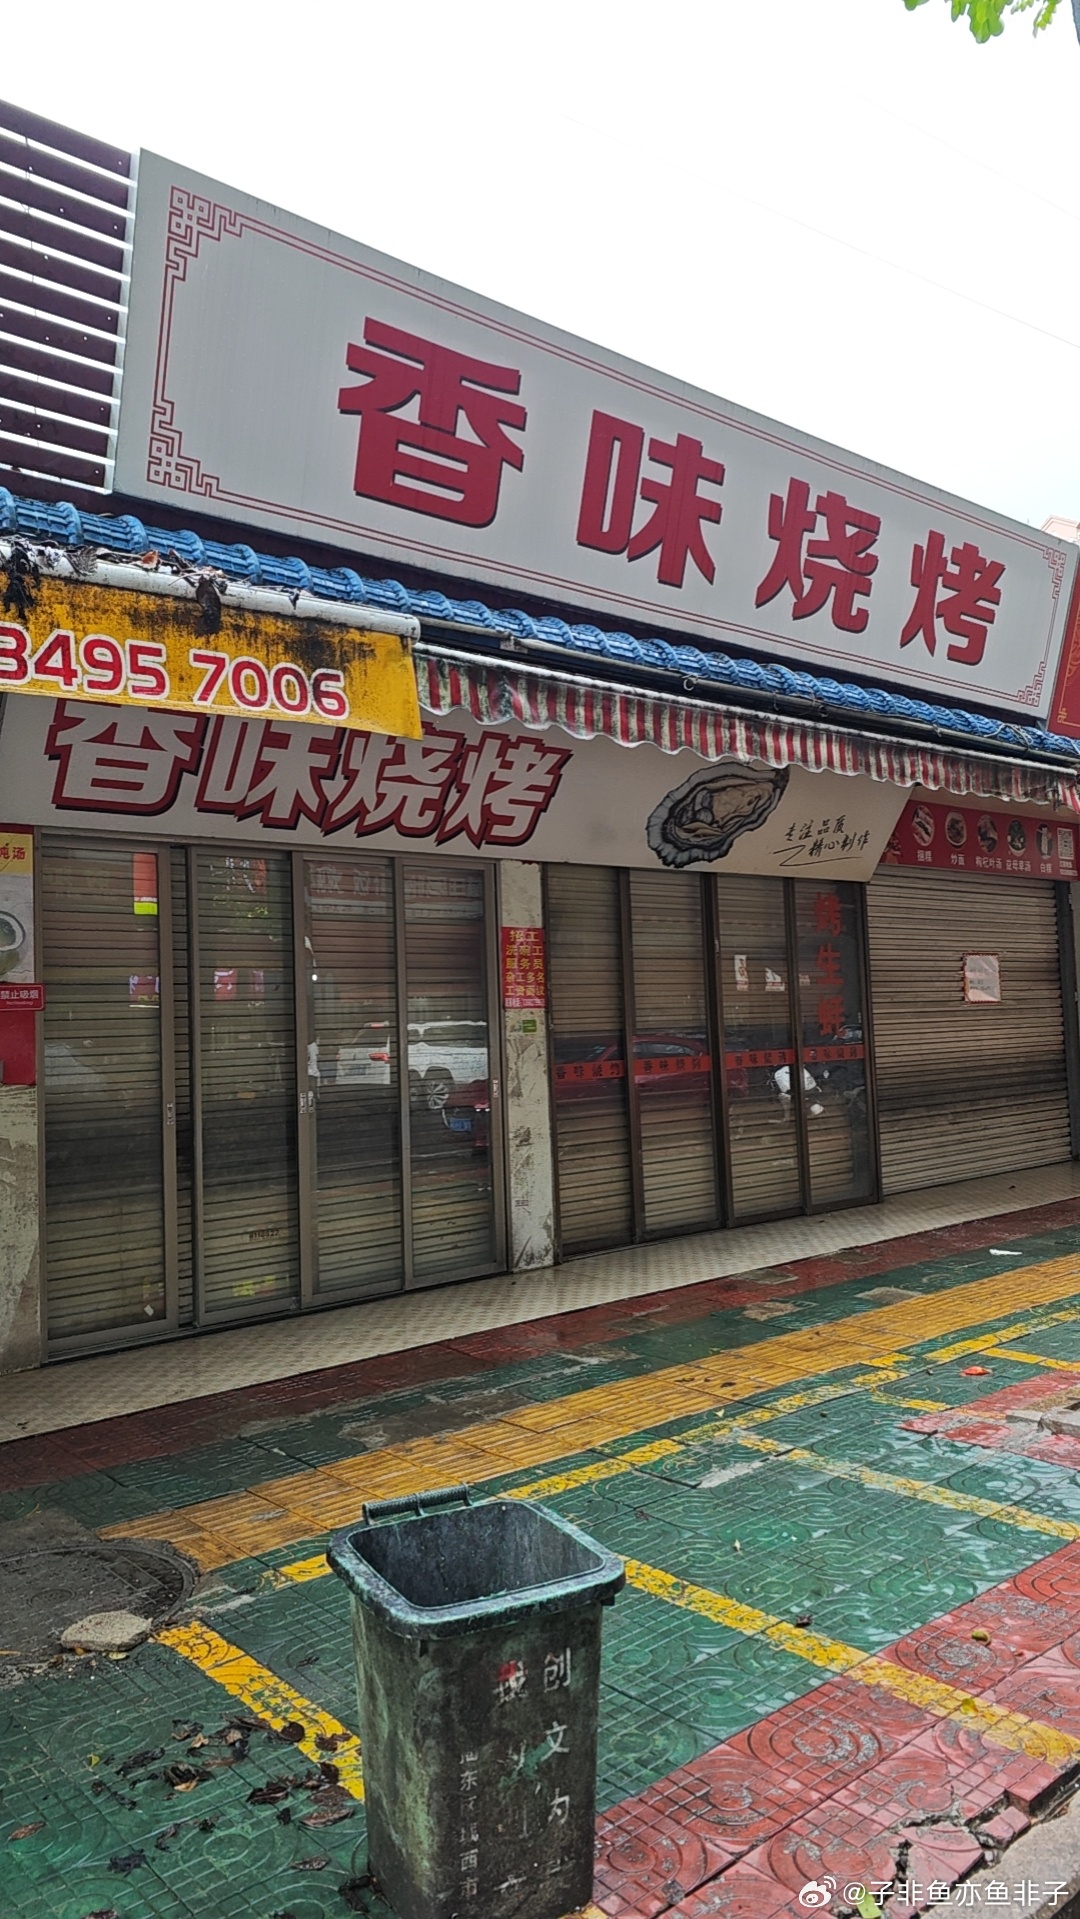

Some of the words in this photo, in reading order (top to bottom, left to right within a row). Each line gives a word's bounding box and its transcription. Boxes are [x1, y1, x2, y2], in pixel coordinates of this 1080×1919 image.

[338, 316, 1006, 668] 香味烧烤
[189, 648, 350, 721] 7006
[44, 699, 574, 850] 香味烧烤
[785, 815, 847, 841] 专注品质
[808, 830, 871, 858] 精心制作
[950, 853, 965, 865] 炒面
[509, 930, 540, 941] 招工
[505, 944, 544, 956] 洗碗工
[505, 958, 544, 970] 服务员
[814, 891, 846, 1038] 烤生蚝
[0, 990, 39, 1000] 禁止吸烟
